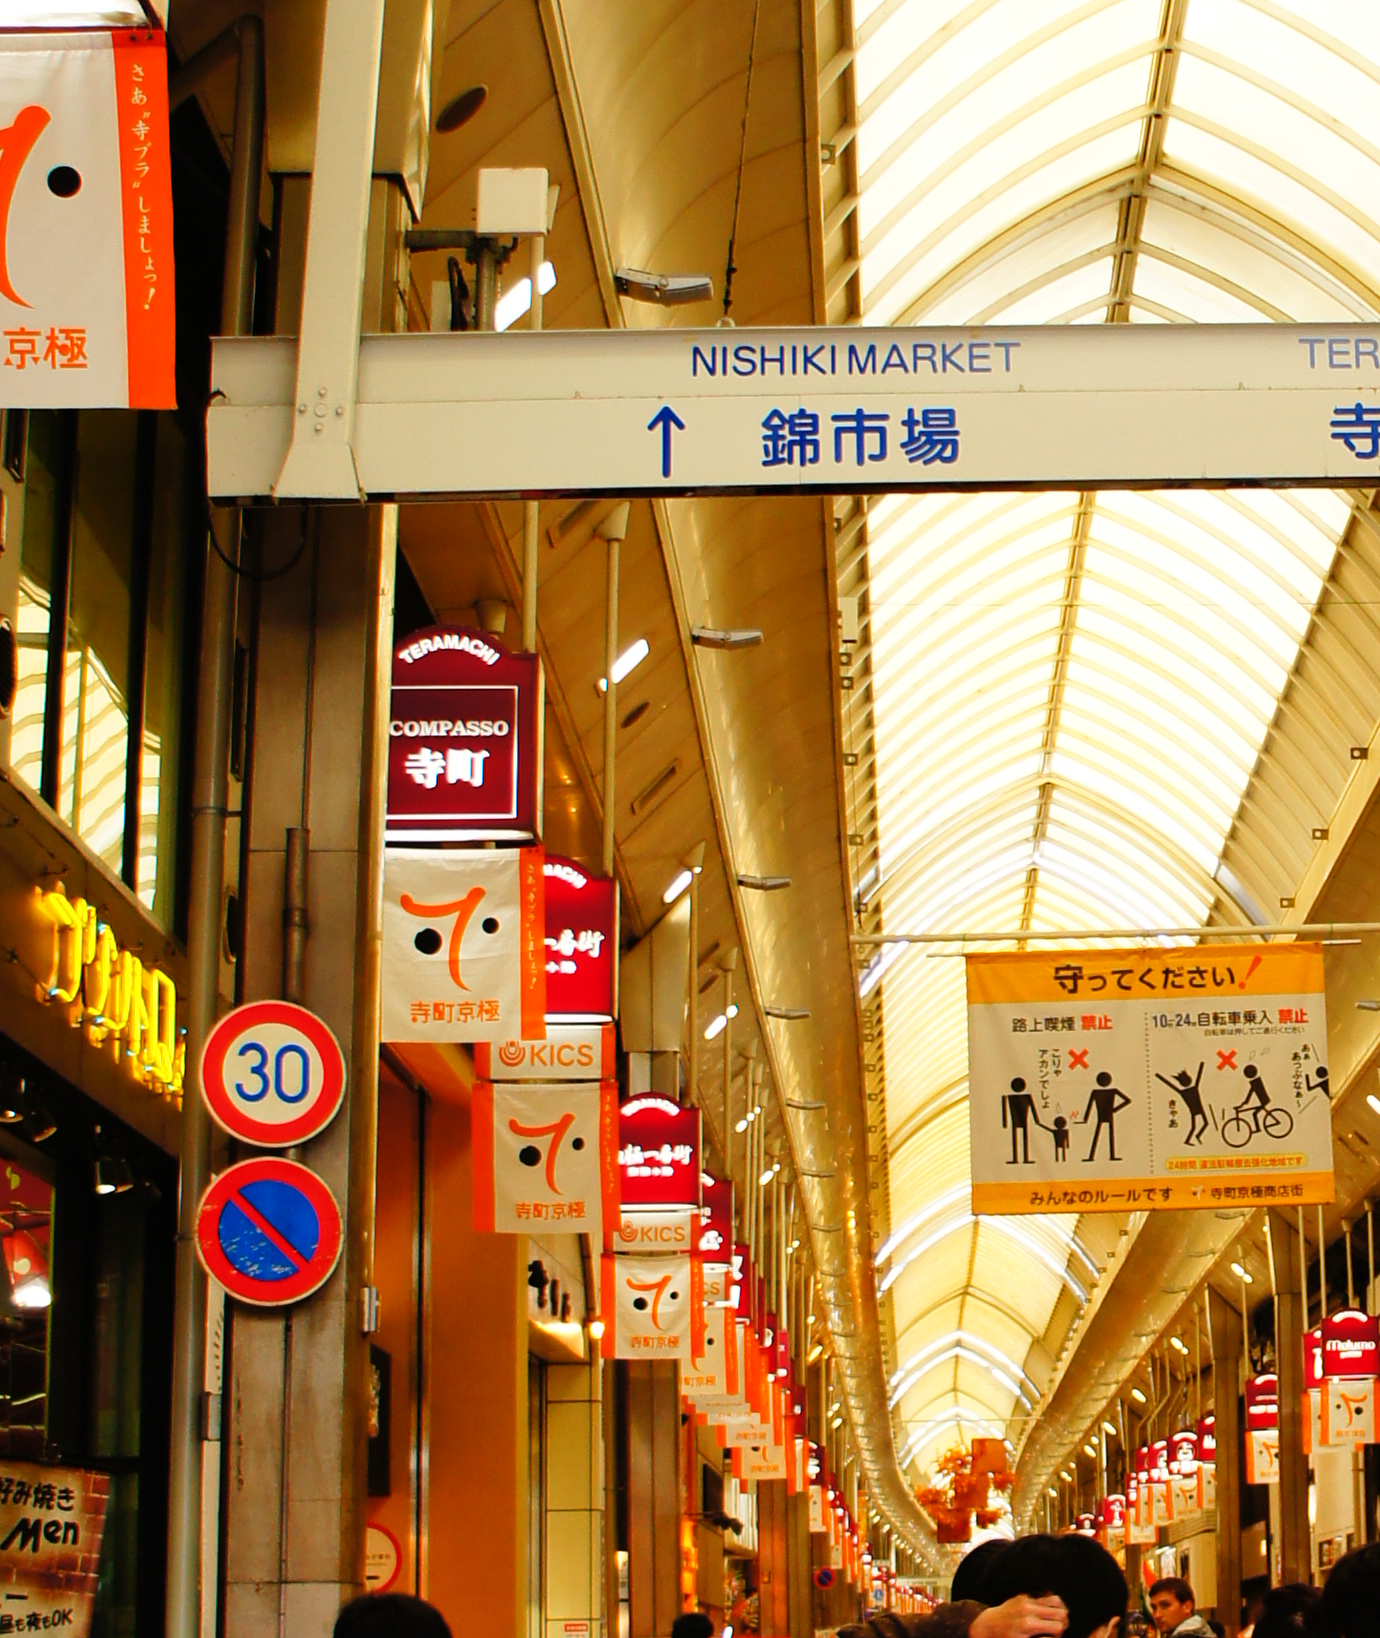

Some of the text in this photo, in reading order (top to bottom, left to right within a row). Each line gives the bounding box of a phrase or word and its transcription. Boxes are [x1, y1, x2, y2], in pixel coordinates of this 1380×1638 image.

[691, 341, 1021, 377] NISHIKI MARKET
[761, 407, 960, 467] 錦市場
[398, 634, 501, 666] TERAMACHI
[389, 720, 510, 737] COMPASSO
[404, 747, 490, 789] 寺町
[1054, 954, 1263, 994] 守ってください!
[410, 1000, 500, 1025] 寺町京極
[1012, 1013, 1113, 1033] 路上喫煙 禁止
[1278, 1008, 1309, 1024] 禁止
[530, 1044, 594, 1067] KICS
[234, 1042, 310, 1105] 30
[1030, 1184, 1304, 1207] みんなのルールです 寺町京極商店街
[516, 1201, 586, 1220] 寺町京極
[641, 1225, 685, 1242] KICS
[1, 1518, 79, 1553] Men
